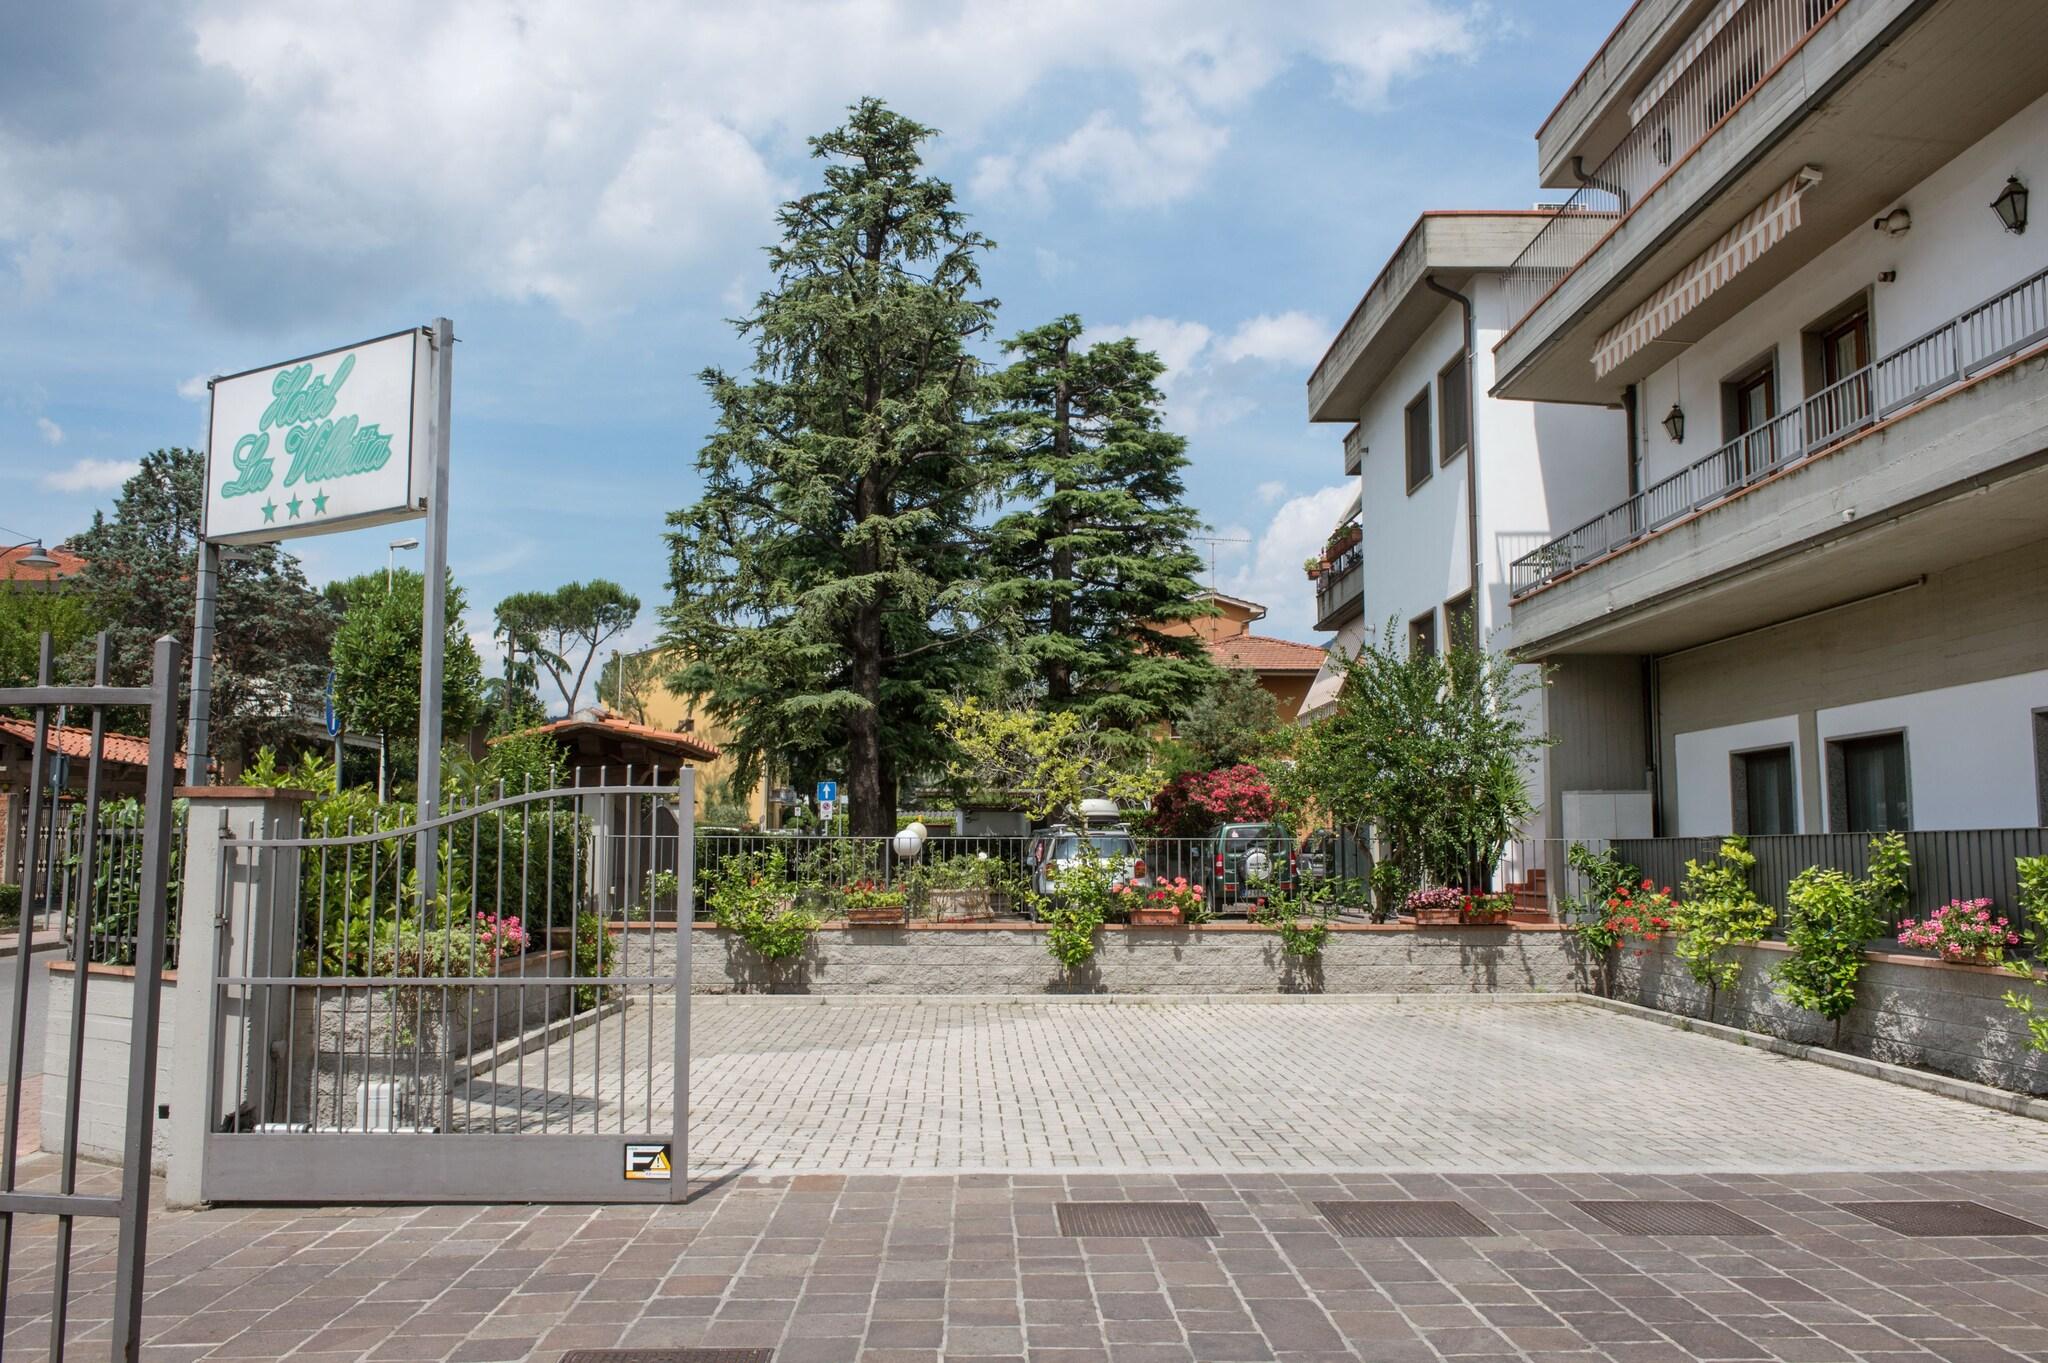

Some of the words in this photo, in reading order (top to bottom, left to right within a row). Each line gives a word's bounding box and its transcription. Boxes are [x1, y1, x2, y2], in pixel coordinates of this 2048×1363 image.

[258, 353, 356, 431] Hotel
[221, 432, 275, 498] La
[283, 414, 394, 487] Villetta
